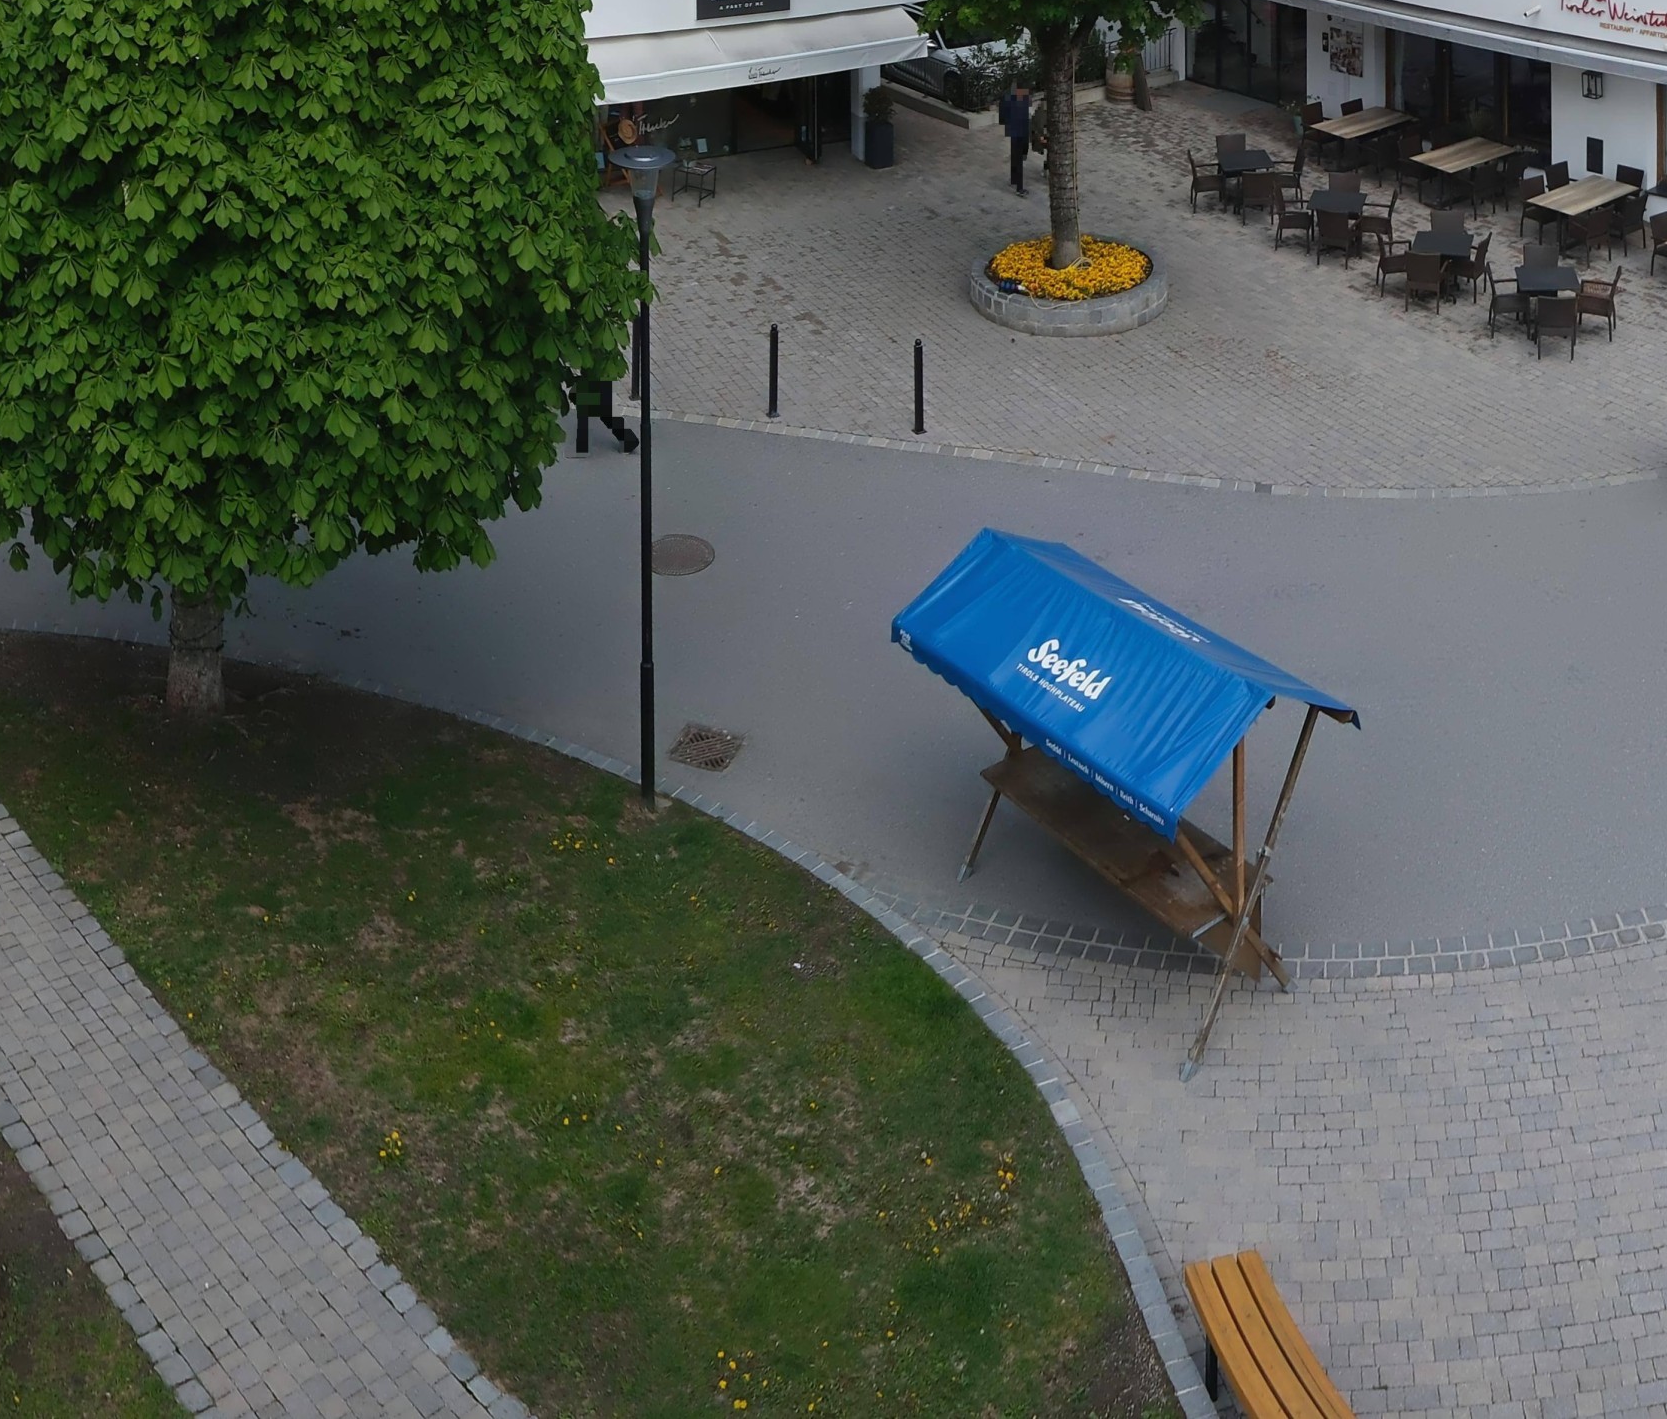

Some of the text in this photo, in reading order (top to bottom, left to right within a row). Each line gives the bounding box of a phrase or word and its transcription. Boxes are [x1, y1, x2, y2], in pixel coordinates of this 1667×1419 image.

[1599, 21, 1634, 34] RESTAURANT
[1015, 662, 1086, 713] TIROLS HOCHPLATEAU
[1027, 638, 1112, 701] Seefeld
